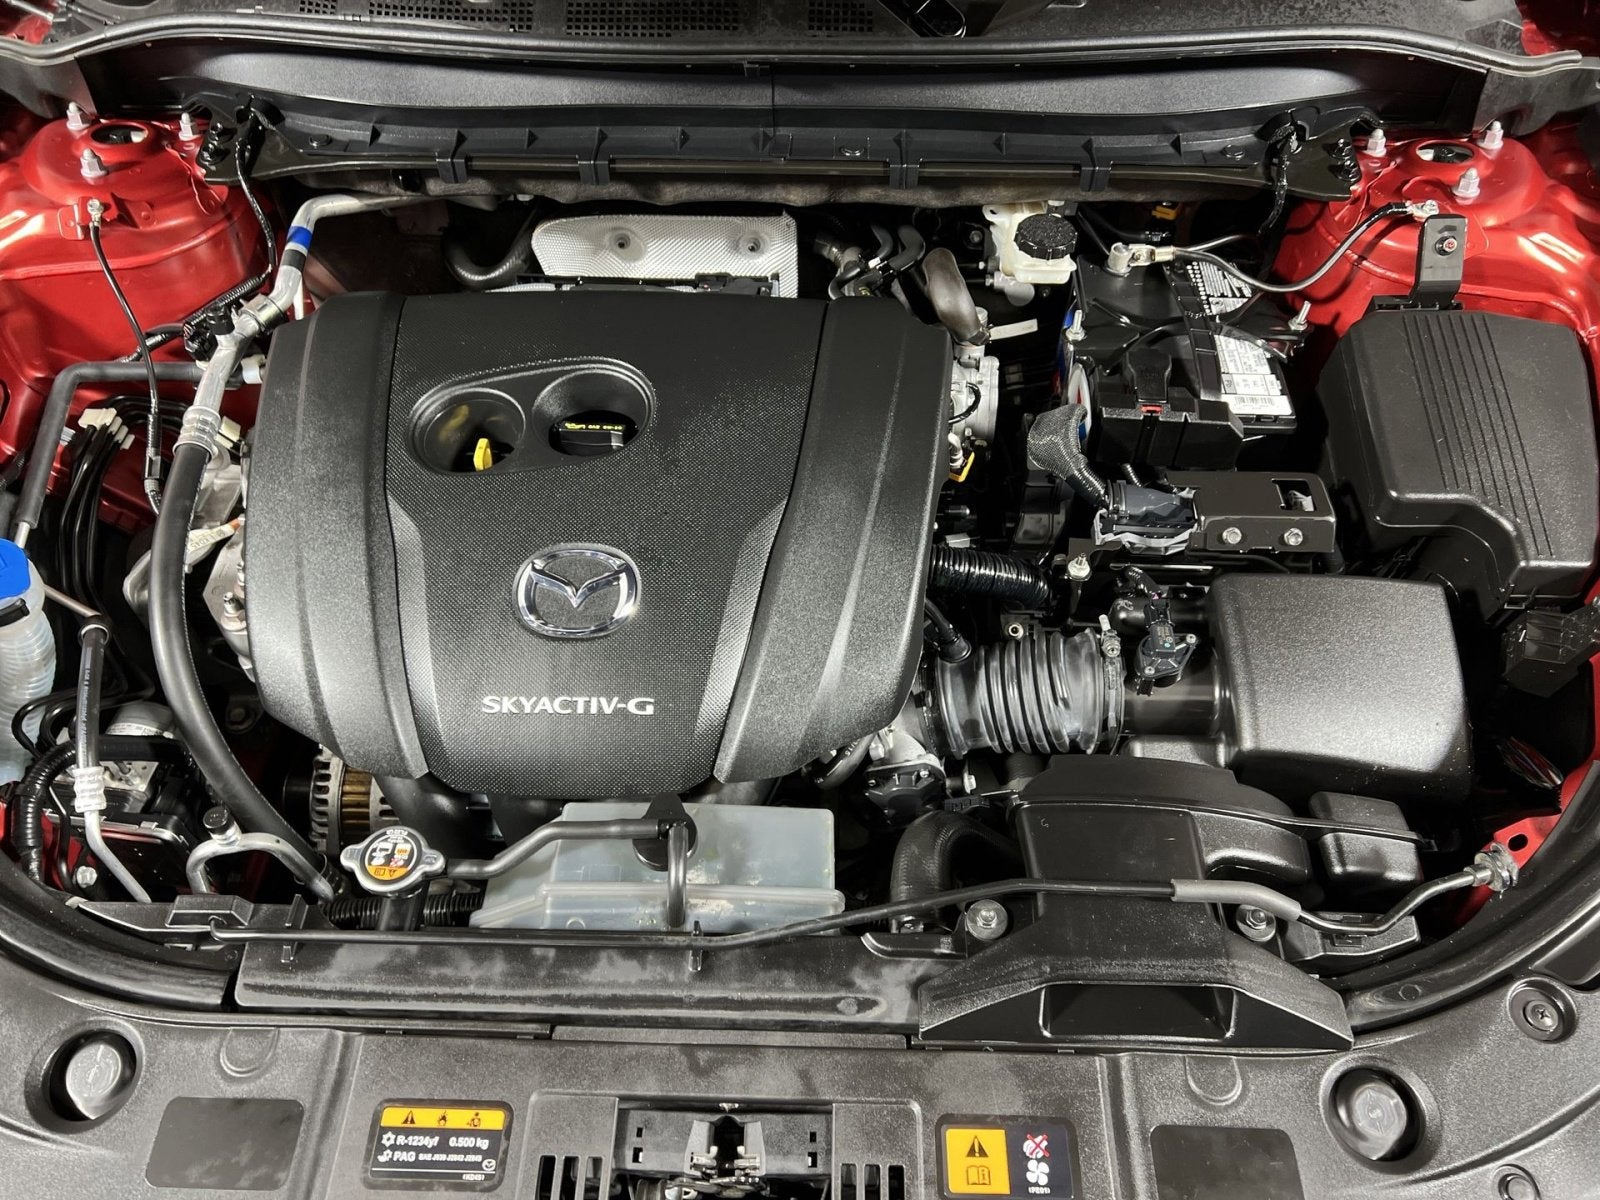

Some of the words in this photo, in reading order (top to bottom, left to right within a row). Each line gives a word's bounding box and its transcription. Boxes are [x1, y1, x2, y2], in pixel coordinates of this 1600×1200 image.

[481, 695, 655, 716] SKYACTIV-G
[395, 1134, 440, 1149] R-1234yf
[448, 1136, 476, 1148] 0.500
[475, 1137, 490, 1151] kg
[392, 1150, 416, 1163] PAG
